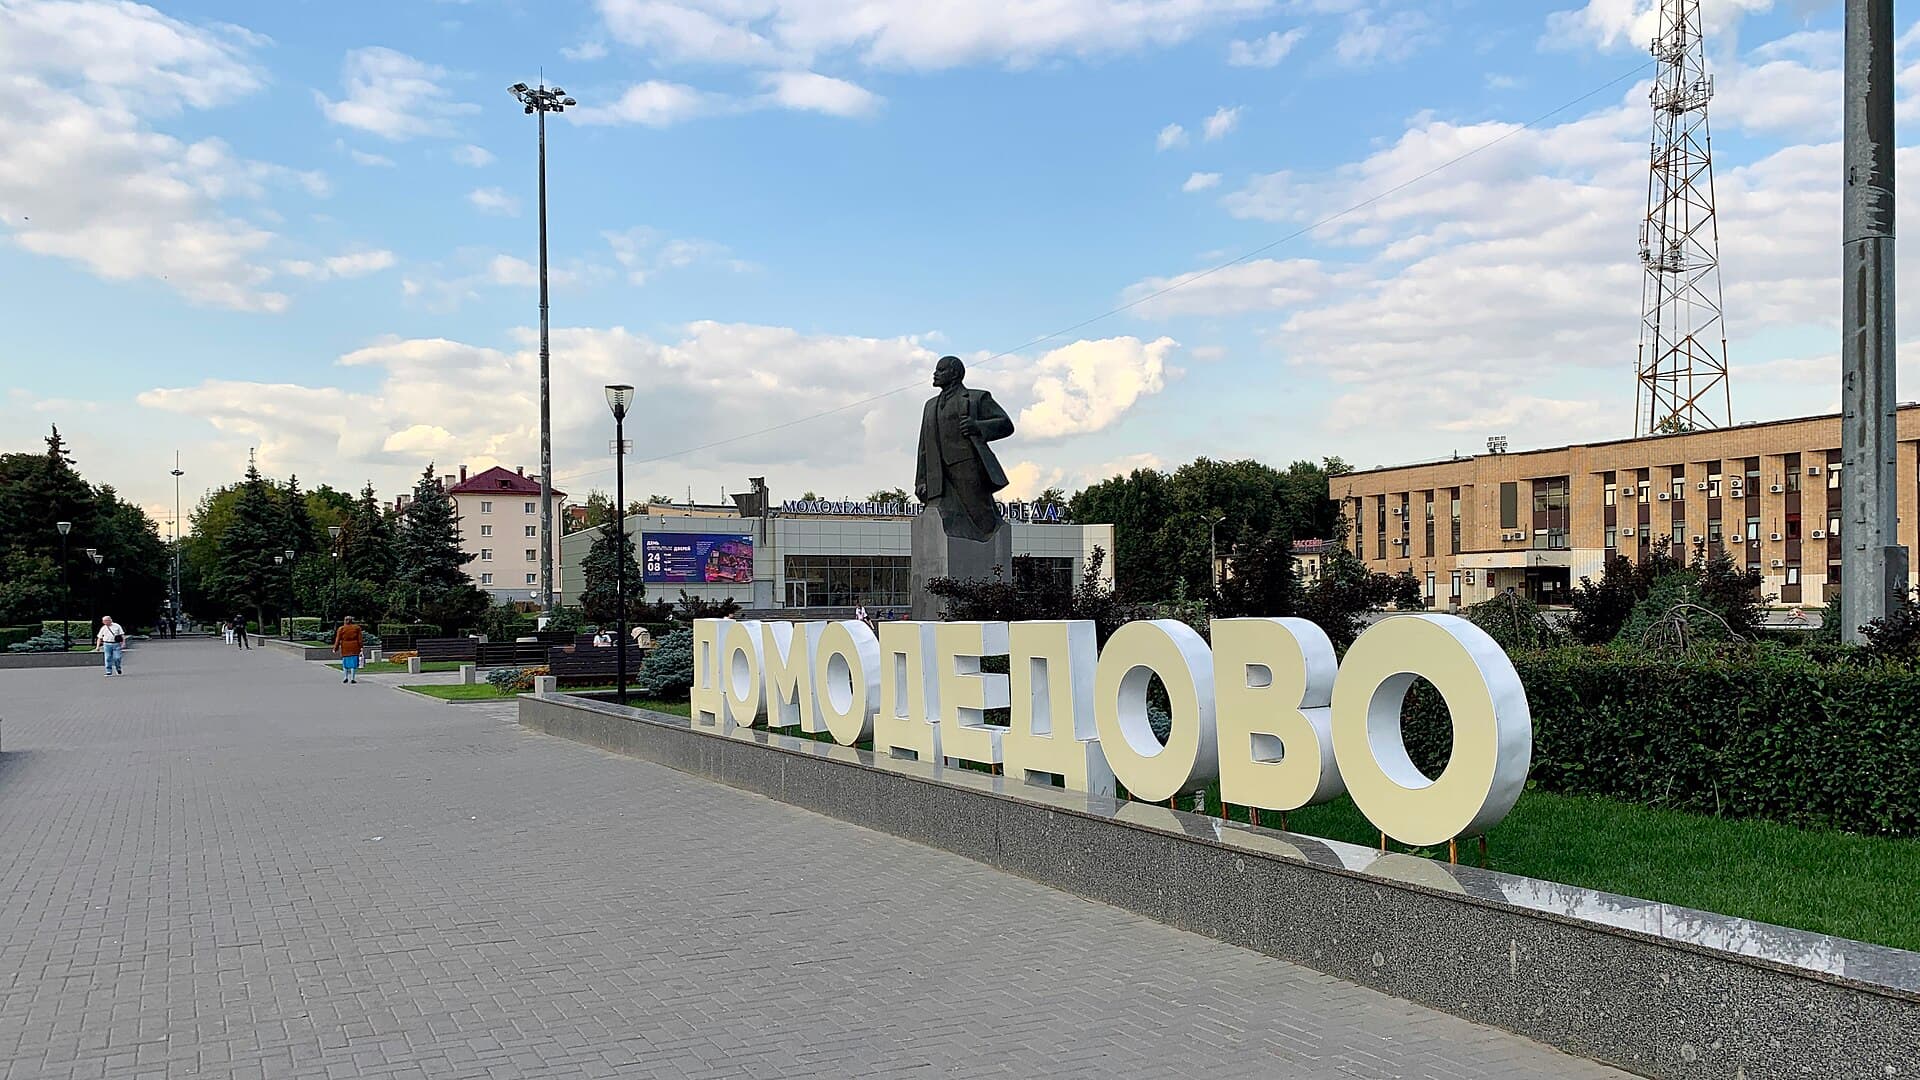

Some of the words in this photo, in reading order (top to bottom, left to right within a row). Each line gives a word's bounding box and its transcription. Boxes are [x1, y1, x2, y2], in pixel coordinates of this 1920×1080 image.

[647, 553, 661, 562] 24
[647, 562, 661, 572] 08
[689, 613, 1532, 847] ДОМОДЕДОВО
